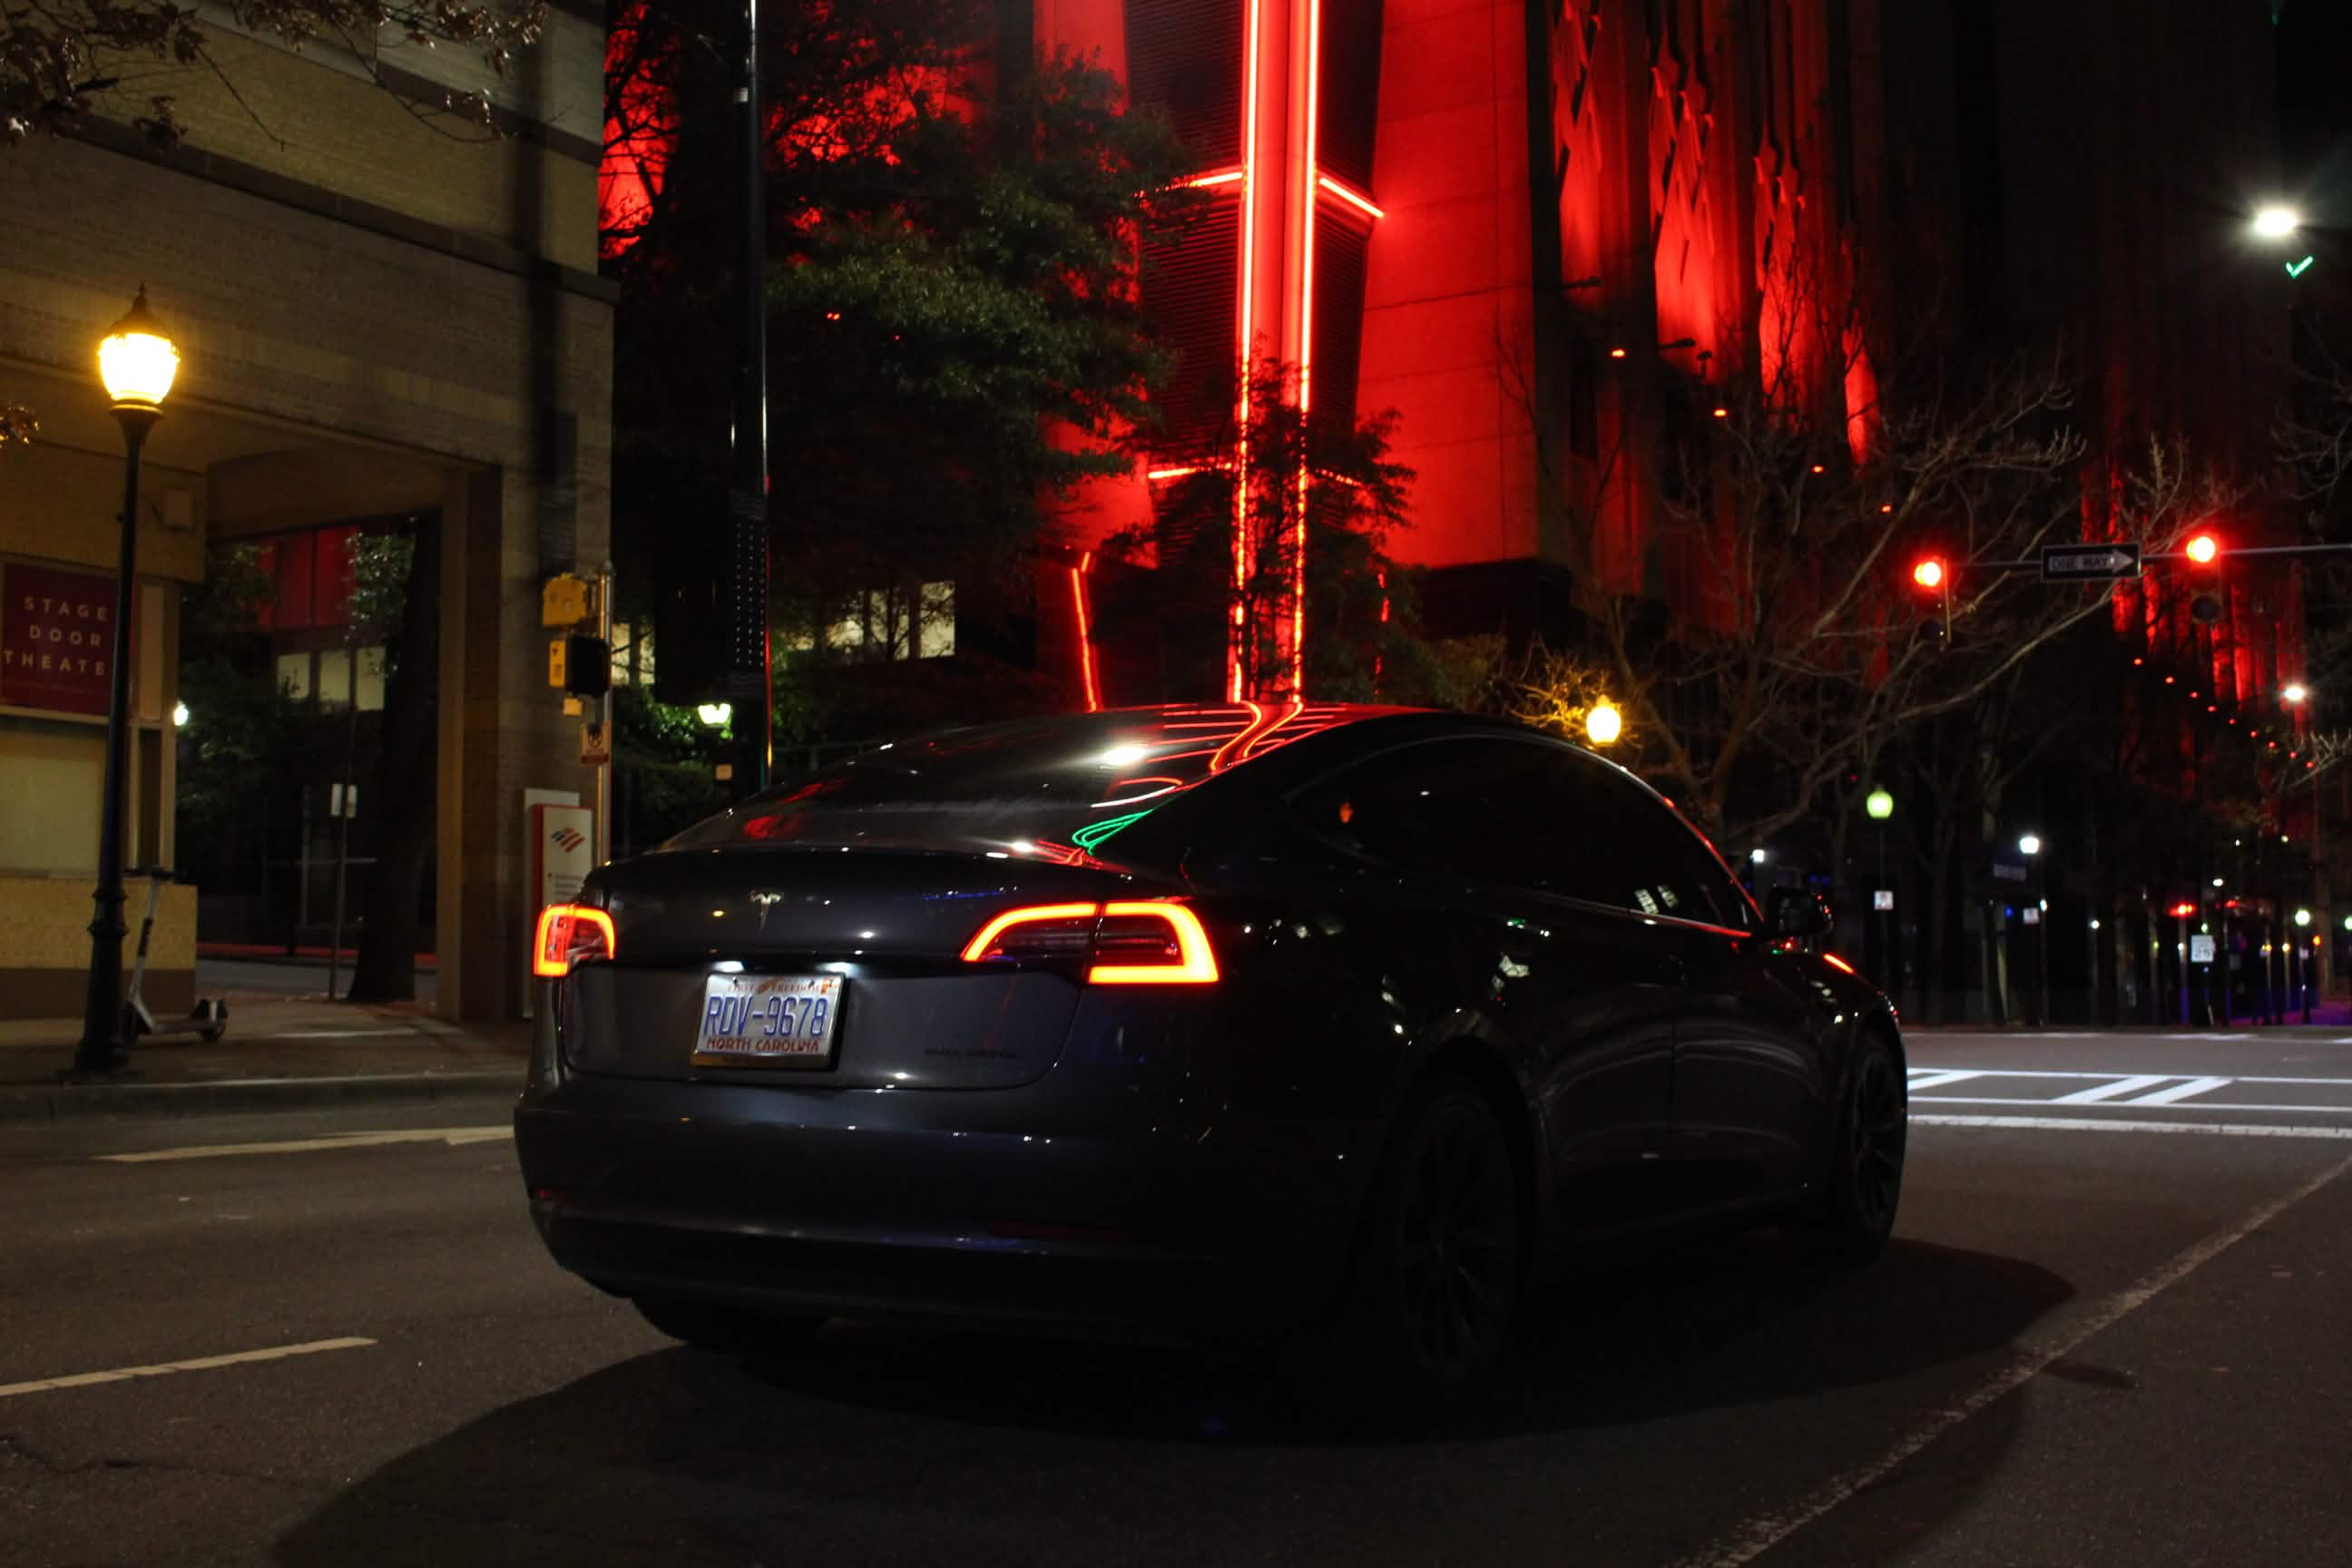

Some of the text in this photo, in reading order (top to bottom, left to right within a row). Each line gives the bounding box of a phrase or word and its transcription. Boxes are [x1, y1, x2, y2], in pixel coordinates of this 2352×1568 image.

[2052, 555, 2109, 571] ONE WAY
[24, 595, 109, 622] STAGE
[29, 624, 103, 647] DOOR
[4, 650, 106, 676] THEATE
[702, 995, 829, 1037] RDV-9678
[706, 1038, 820, 1053] NORTH CAROLINA
